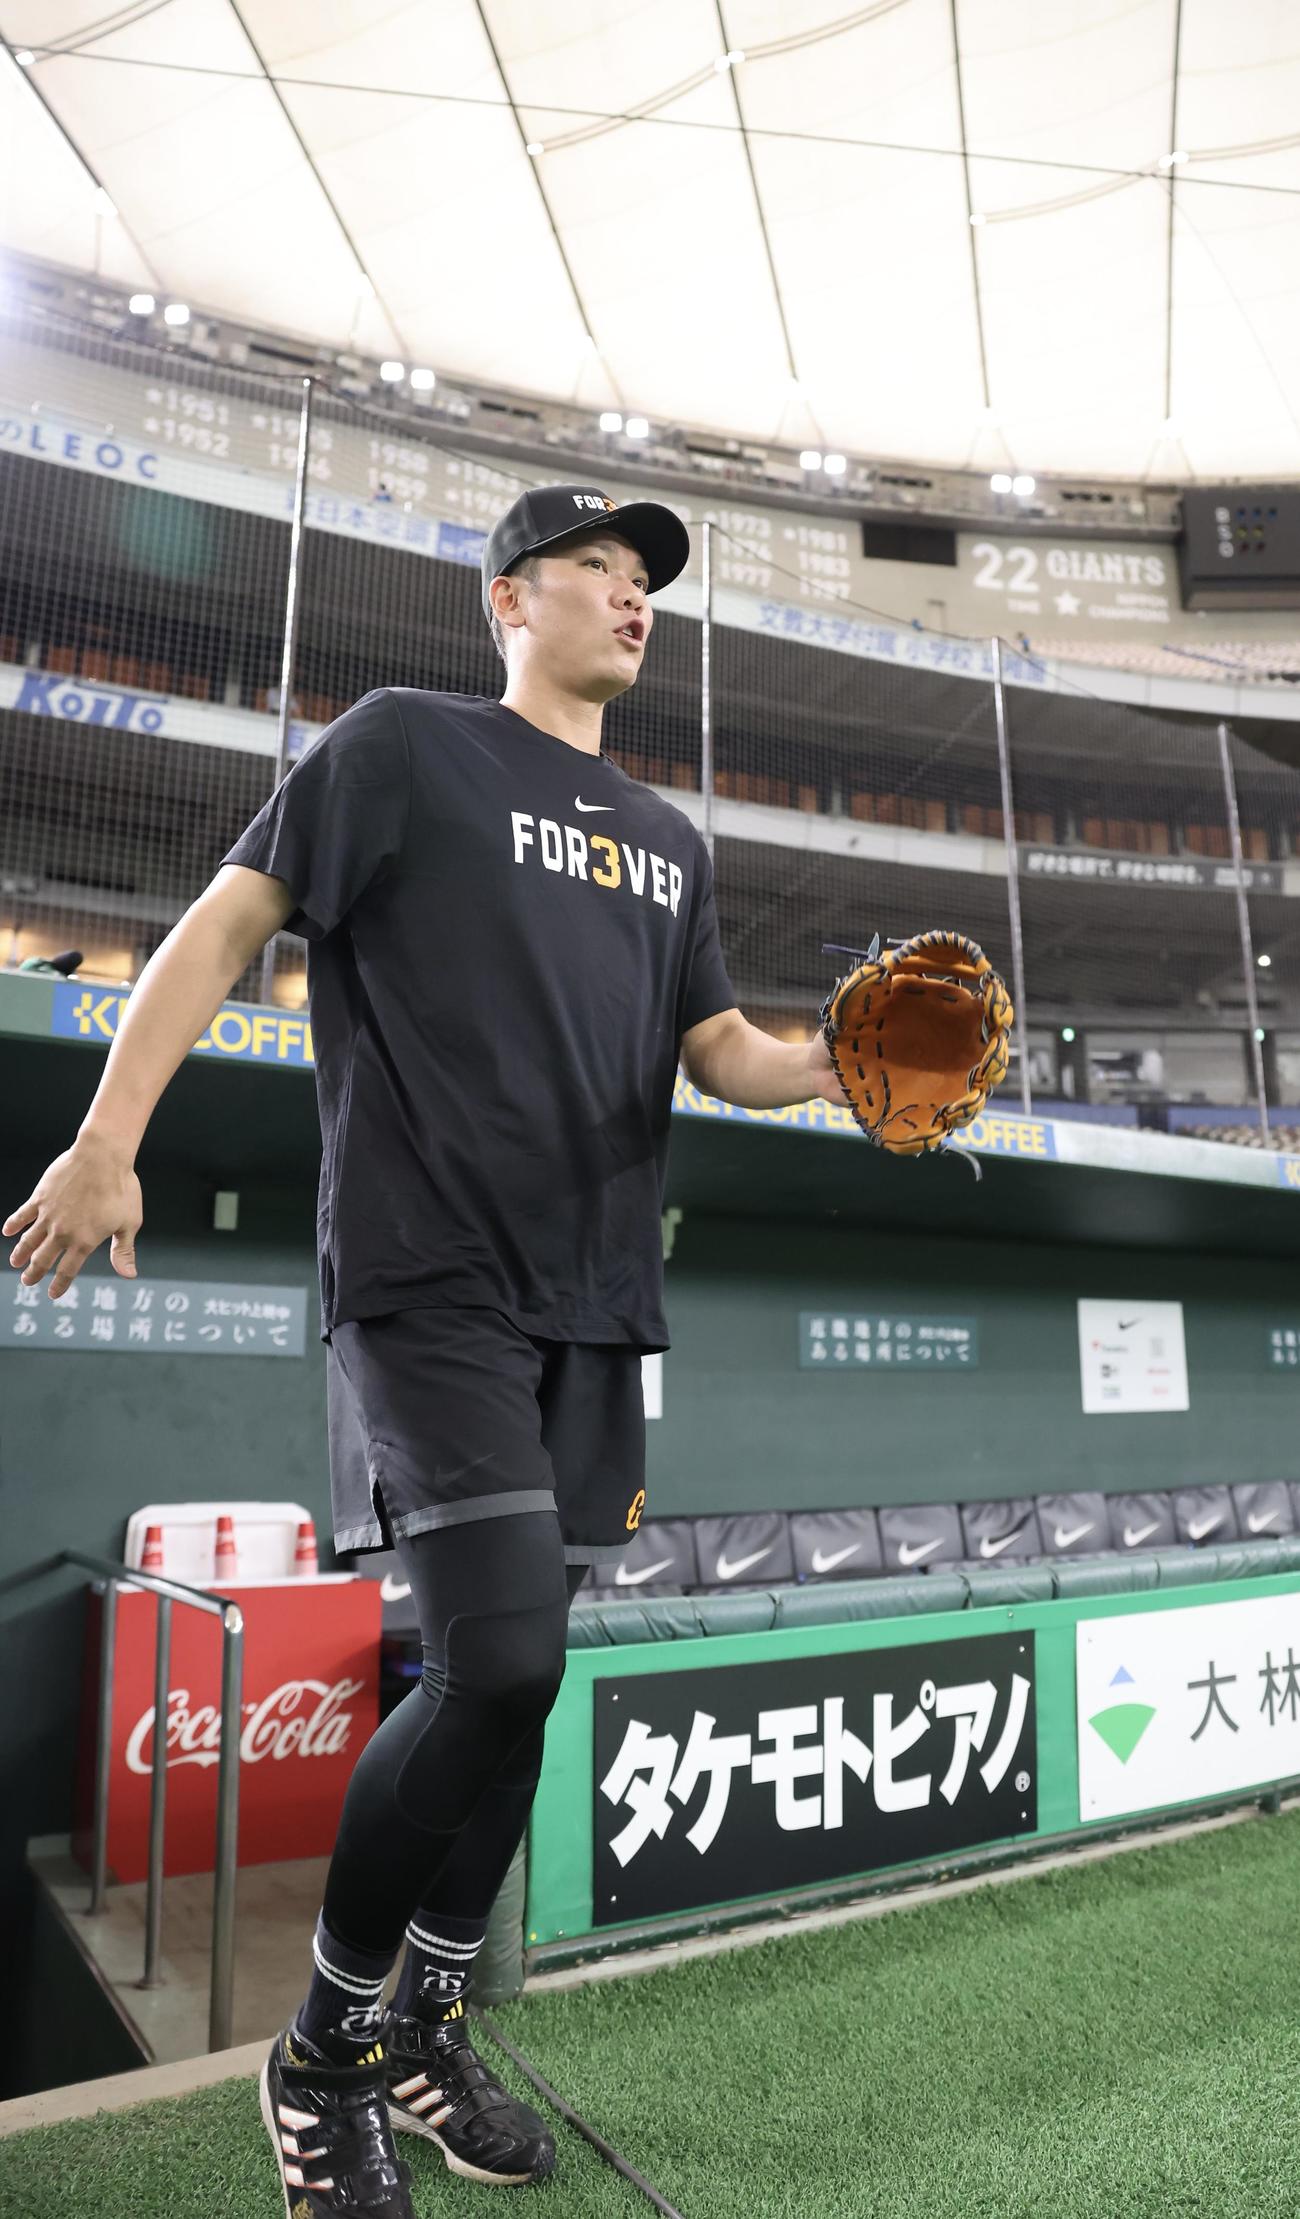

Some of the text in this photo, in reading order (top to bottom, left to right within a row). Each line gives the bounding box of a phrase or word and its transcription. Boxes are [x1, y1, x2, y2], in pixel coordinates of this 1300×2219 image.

[167, 389, 229, 425] 1951
[164, 418, 230, 457] 1952
[270, 444, 331, 480] 196
[572, 495, 619, 513] FOR3
[972, 542, 1165, 593] 22 GIANTS
[511, 811, 682, 918] FOR3VER
[13, 1311, 289, 1346] ある場所について
[1187, 1647, 1300, 1742] 大林
[600, 1673, 1031, 1868] タケモトピアノ
